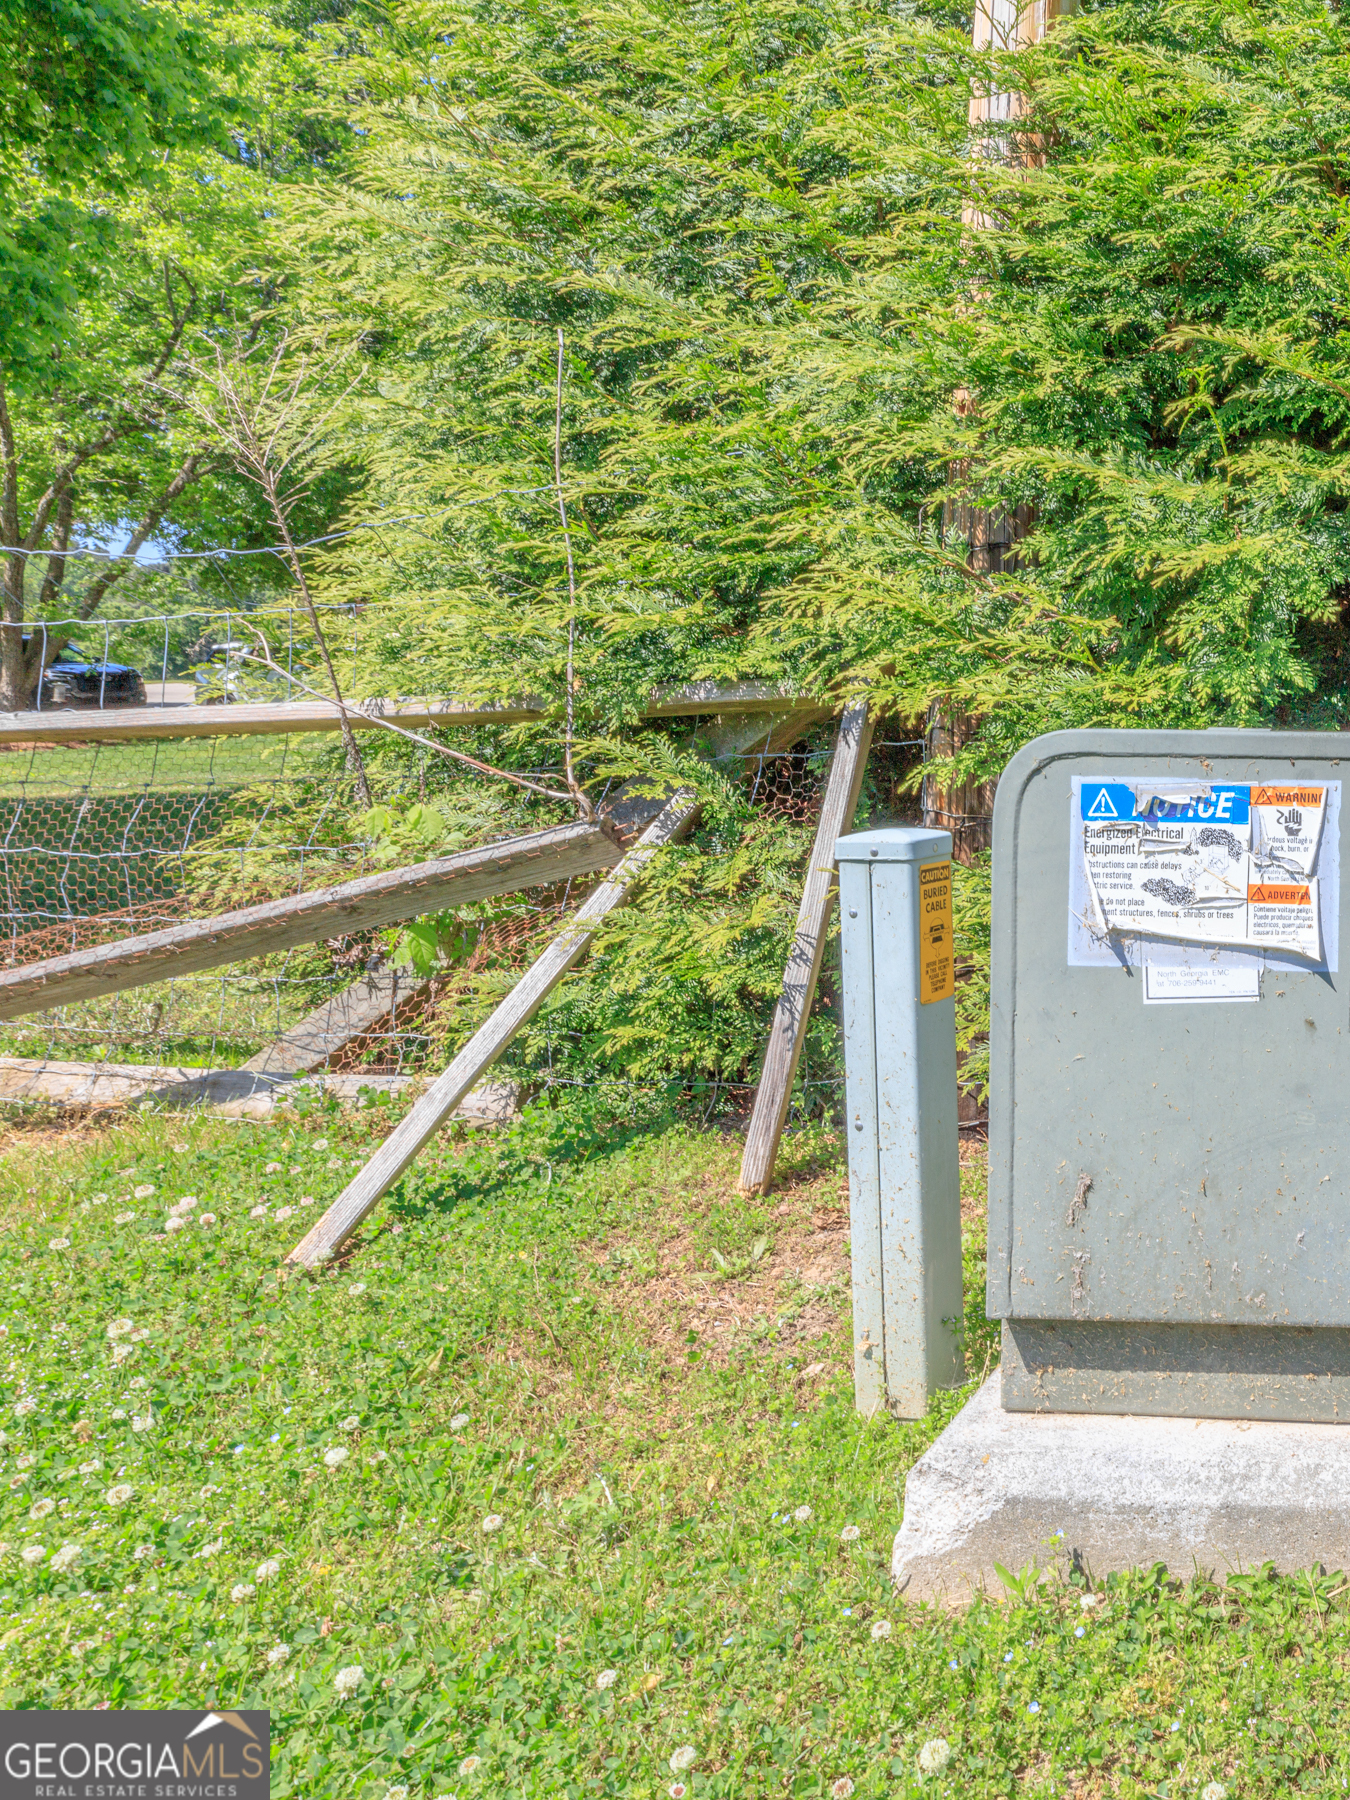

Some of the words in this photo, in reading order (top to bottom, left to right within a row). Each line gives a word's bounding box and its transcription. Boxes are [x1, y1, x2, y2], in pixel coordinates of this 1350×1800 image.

[1136, 826, 1184, 839] Electrical
[1287, 836, 1307, 845] voltage
[1084, 841, 1136, 856] Equipment
[1089, 860, 1124, 869] bstructions
[1161, 861, 1182, 871] delays
[921, 867, 949, 883] CAUTION
[1102, 872, 1132, 880] restoring
[1109, 882, 1135, 890] service.
[923, 885, 948, 900] BURIED
[925, 899, 947, 914] CABLE
[1106, 897, 1114, 905] do
[1115, 898, 1126, 906] not
[1127, 898, 1145, 907] place
[1119, 909, 1155, 918] structures,
[1183, 910, 1206, 918] shrubs
[1216, 911, 1234, 919] trees
[1253, 905, 1276, 913] Contiene
[1157, 970, 1177, 978] North
[1180, 970, 1208, 978] Georgia
[1212, 969, 1230, 977] EMC
[1168, 979, 1217, 987] 706-259-9441
